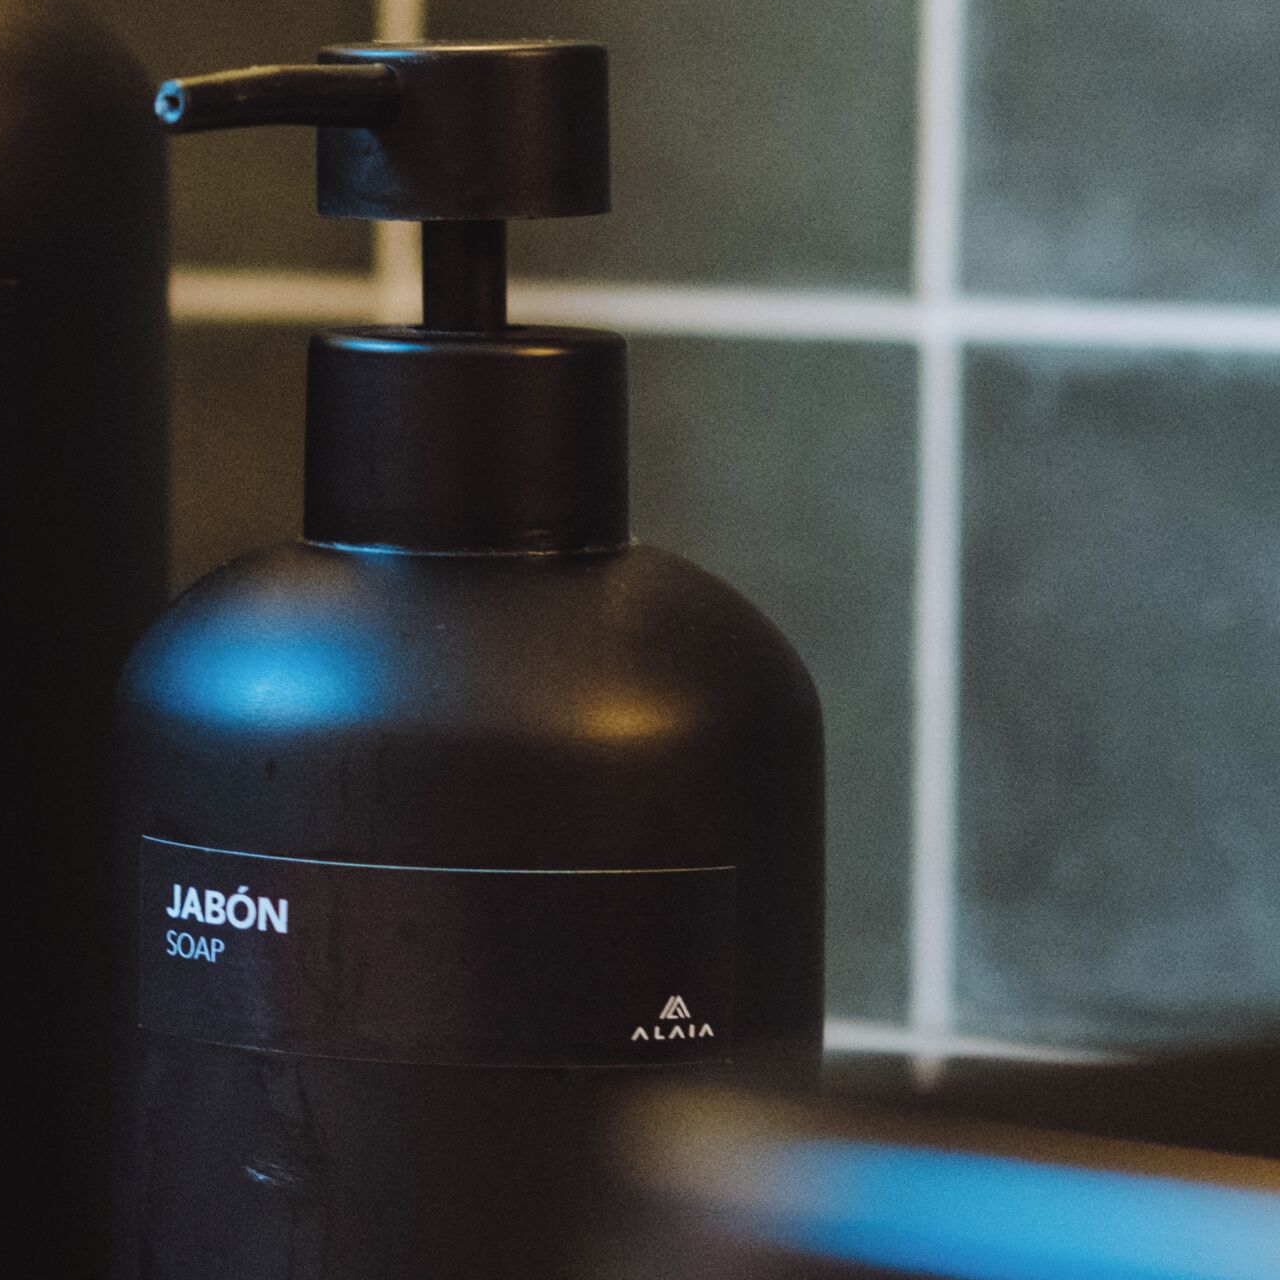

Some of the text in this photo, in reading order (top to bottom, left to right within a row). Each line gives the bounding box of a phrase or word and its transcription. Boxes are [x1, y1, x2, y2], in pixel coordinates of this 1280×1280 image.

[166, 883, 289, 934] JABÓN
[166, 929, 225, 963] SOAP
[631, 1023, 714, 1040] ALAIA
